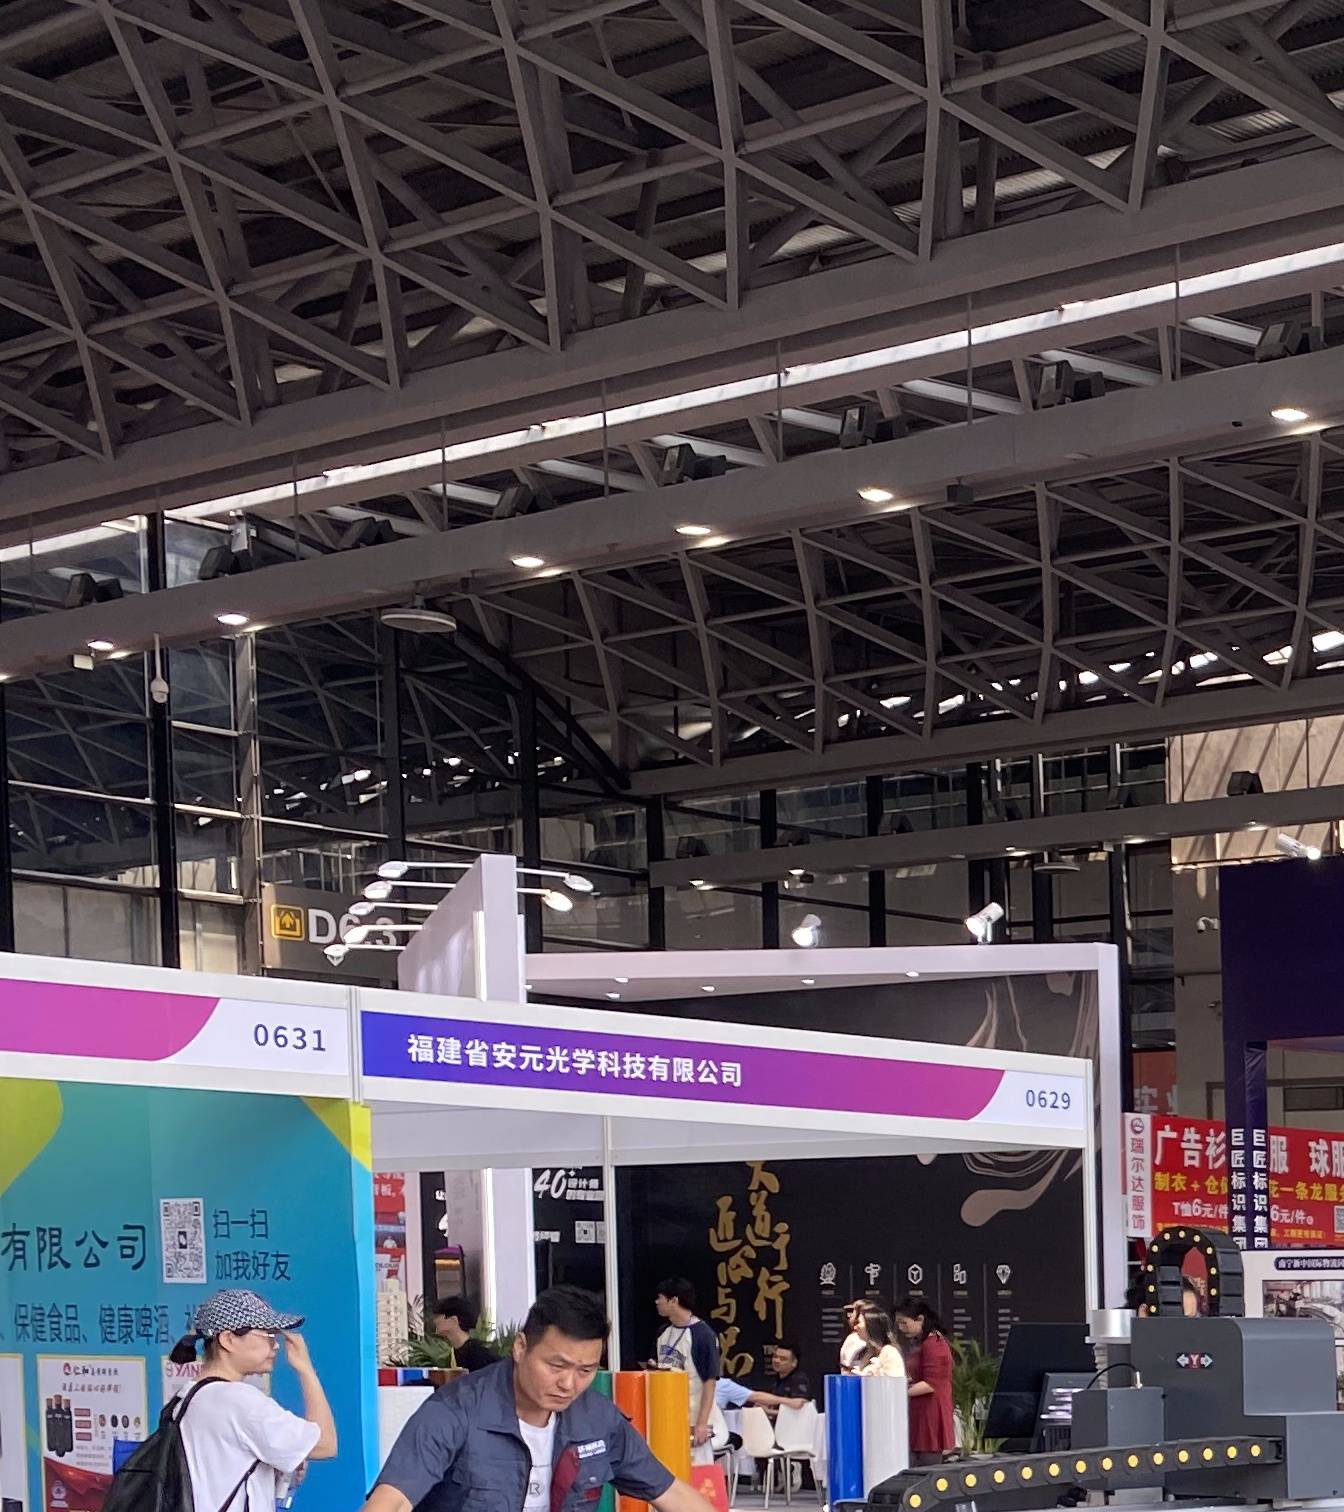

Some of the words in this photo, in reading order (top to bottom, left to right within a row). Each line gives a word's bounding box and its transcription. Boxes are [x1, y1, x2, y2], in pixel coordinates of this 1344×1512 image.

[253, 1024, 327, 1053] 0631
[407, 1034, 742, 1087] 福建省安元光学科技有限公司
[1025, 1089, 1071, 1111] 0629
[1155, 1125, 1226, 1169] 广告衫
[1154, 1172, 1187, 1191] 制衣
[1231, 1128, 1246, 1248] 巨匠标识集团
[1252, 1129, 1268, 1248] 巨匠标识集团
[213, 1209, 268, 1239] 扫一扫
[1, 1223, 146, 1272] 有限公司
[215, 1250, 291, 1281] 加我好友
